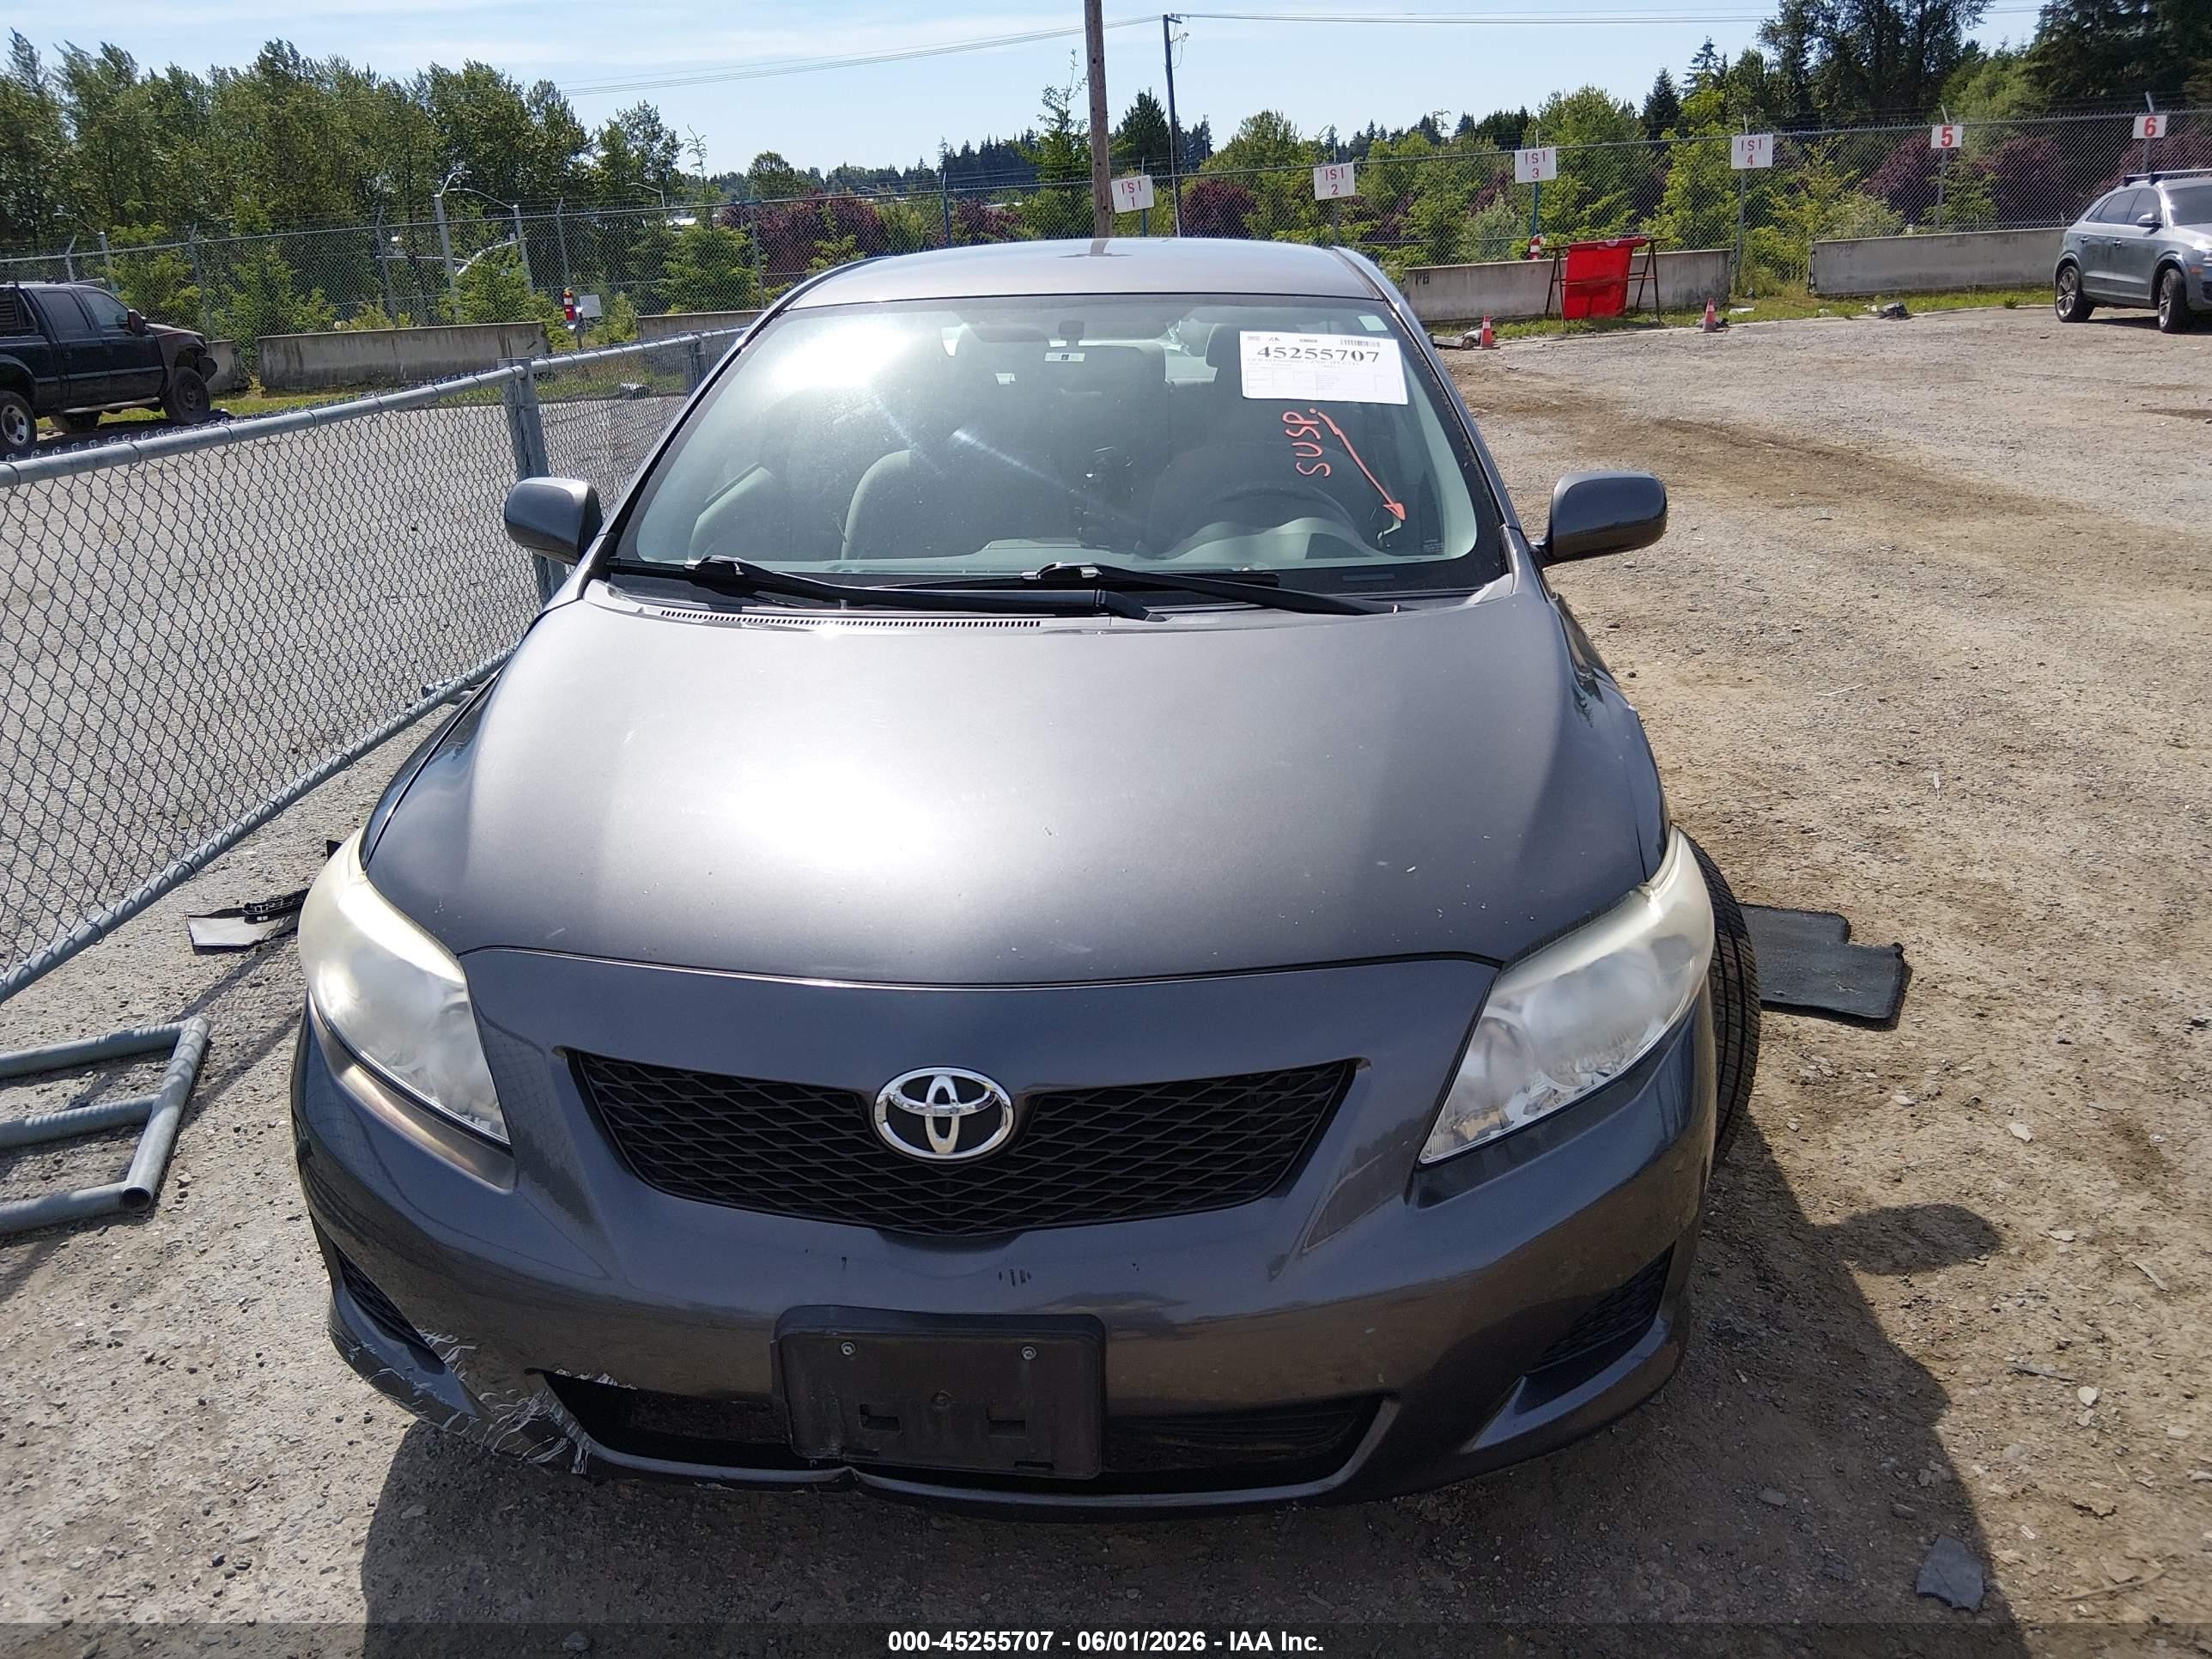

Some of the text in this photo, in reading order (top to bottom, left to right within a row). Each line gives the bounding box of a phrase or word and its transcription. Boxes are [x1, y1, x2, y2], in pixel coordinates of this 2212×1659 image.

[2143, 117, 2157, 137] 6
[1941, 126, 1954, 147] 5
[1747, 154, 1753, 166] 4
[1531, 167, 1540, 179] 3
[1331, 184, 1339, 195] 2
[1256, 346, 1380, 363] 45255707
